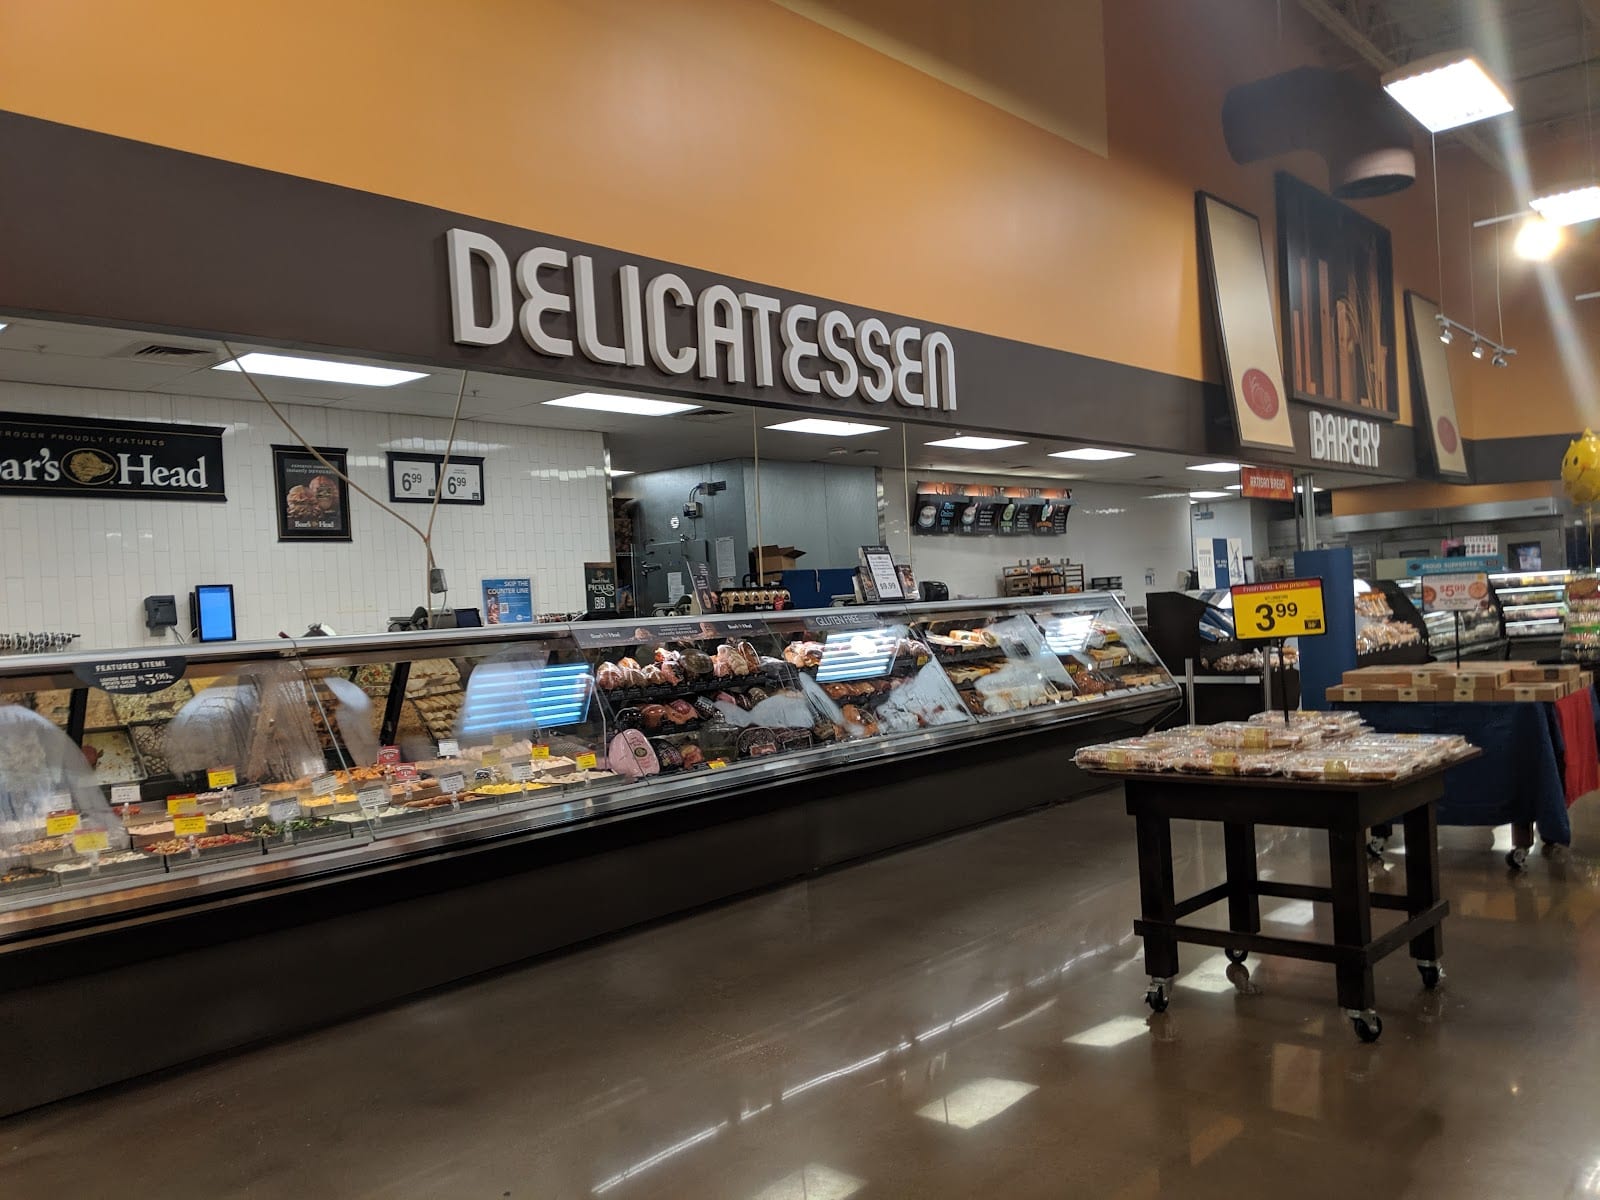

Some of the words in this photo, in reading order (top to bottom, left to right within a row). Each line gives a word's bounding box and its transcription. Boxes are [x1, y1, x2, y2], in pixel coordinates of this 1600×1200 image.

[446, 228, 958, 412] DELICATESSEN
[51, 433, 103, 443] PROUDLY
[108, 437, 166, 447] FEATURES
[1308, 410, 1381, 468] BAKERY
[0, 447, 61, 481] ar's
[117, 453, 208, 489] Head
[1249, 475, 1269, 488] ARTISAN
[1270, 478, 1286, 490] BREAD
[1242, 584, 1258, 592] Fresh
[815, 614, 844, 626] GLUTEN
[845, 613, 861, 624] FREE
[95, 663, 140, 672] FEATURED
